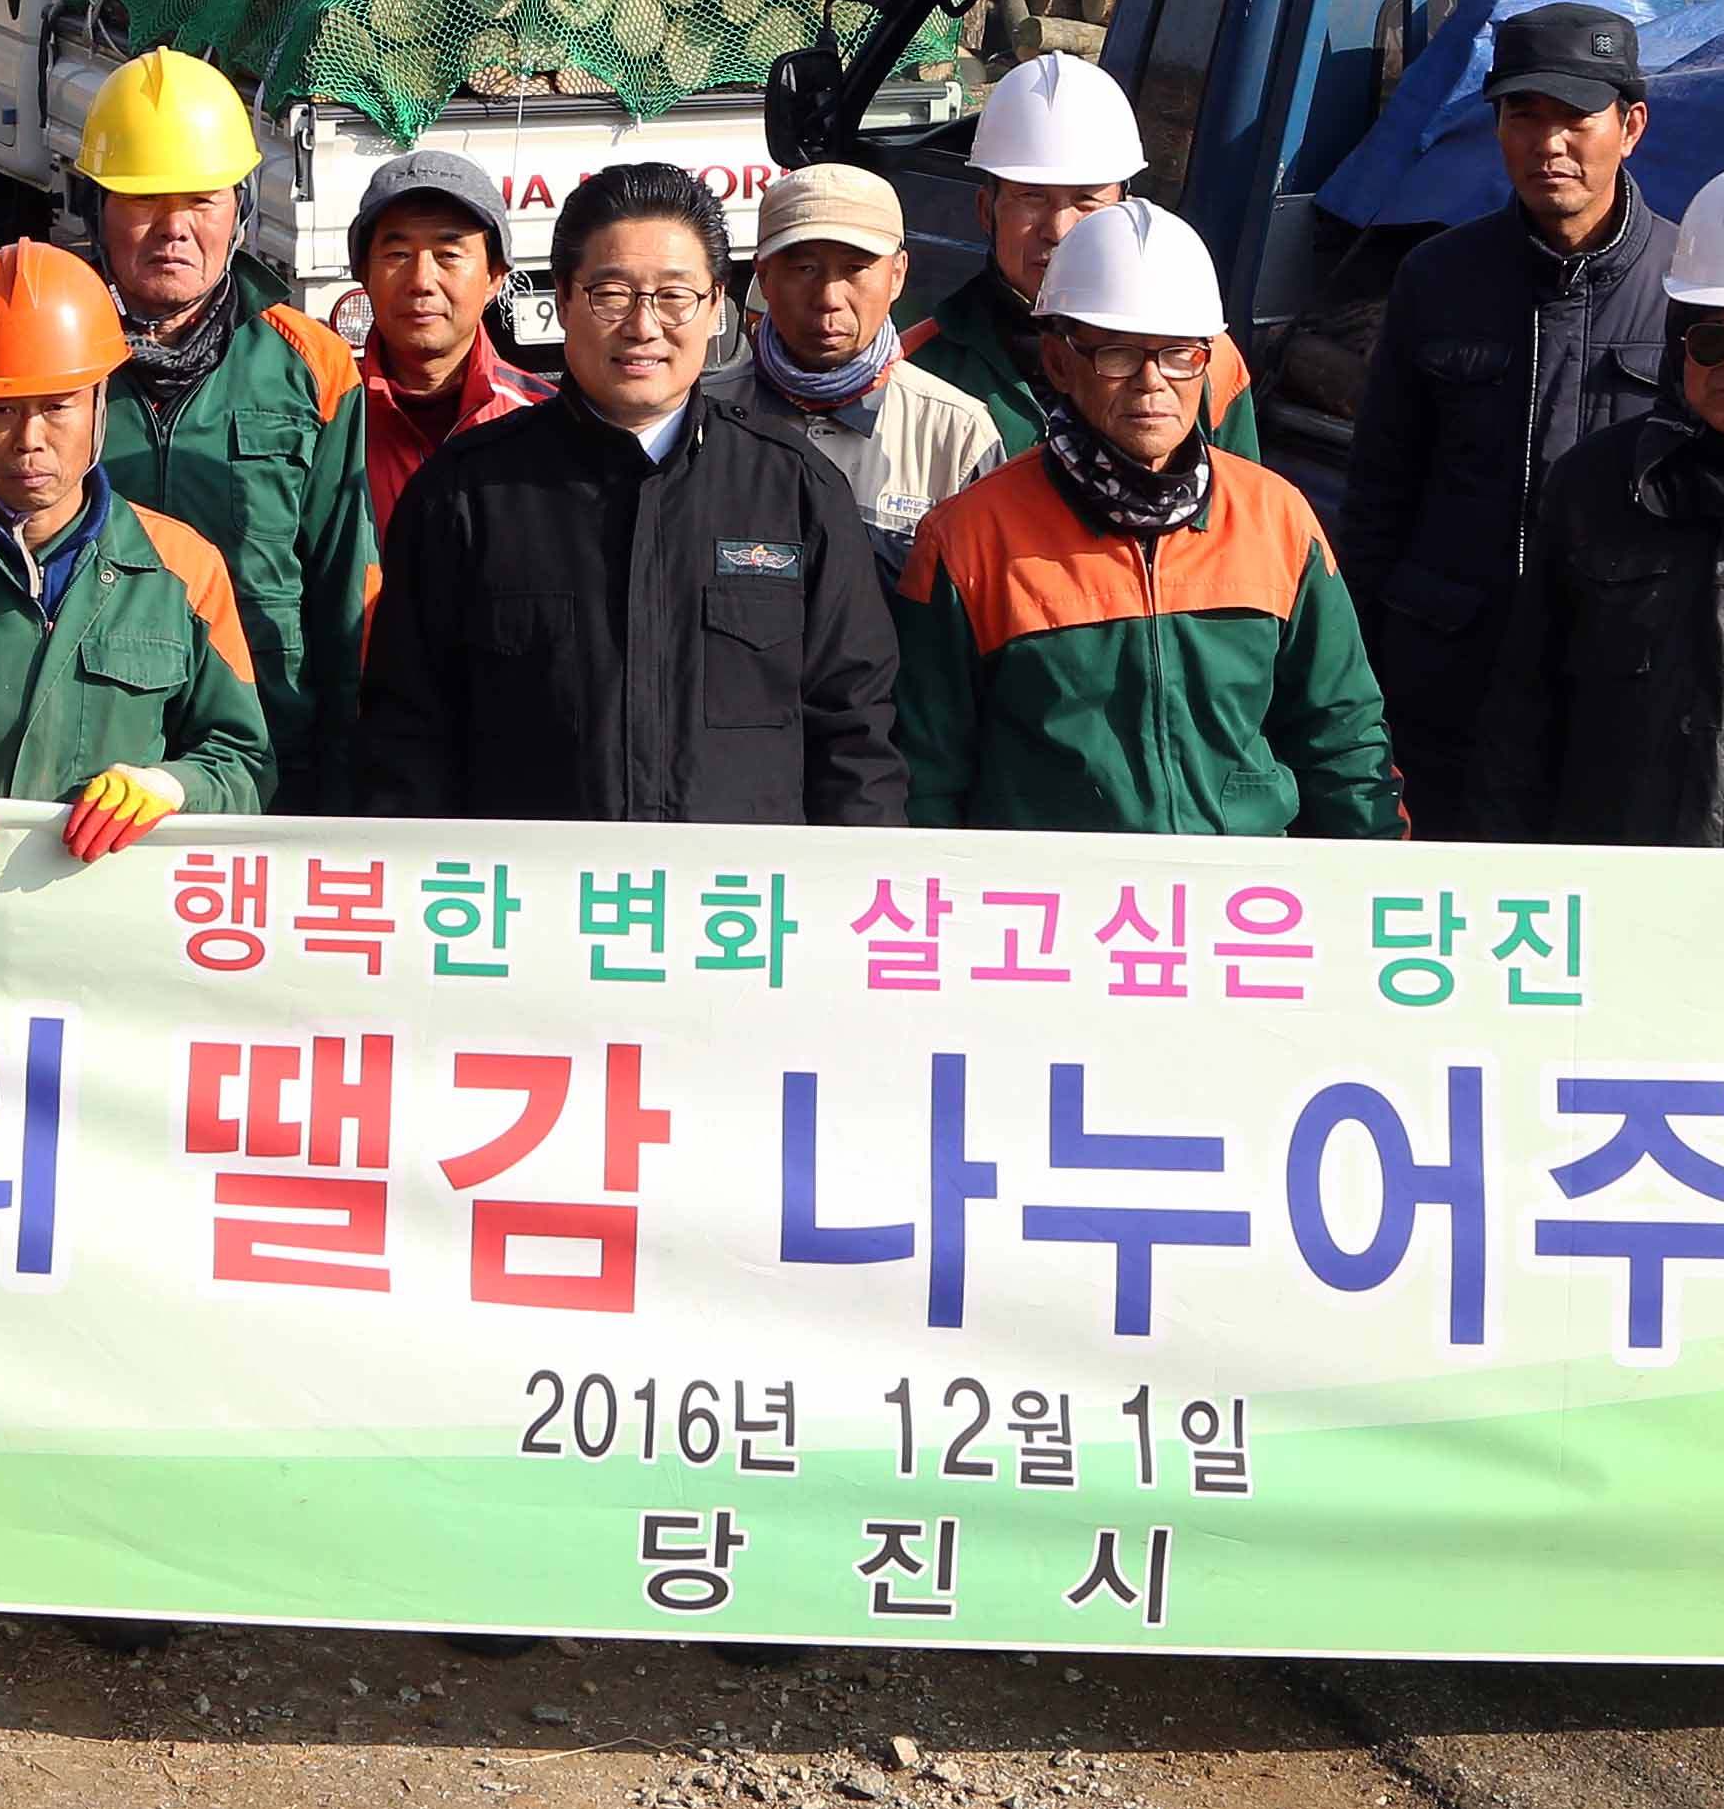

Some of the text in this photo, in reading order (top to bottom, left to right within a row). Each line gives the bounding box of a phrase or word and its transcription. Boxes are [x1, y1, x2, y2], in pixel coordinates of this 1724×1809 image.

[174, 854, 1583, 1007] 행복한 변화 살고싶은 당진
[185, 1032, 671, 1313] 땔감
[520, 1370, 1252, 1493] 2016년 12월 1일
